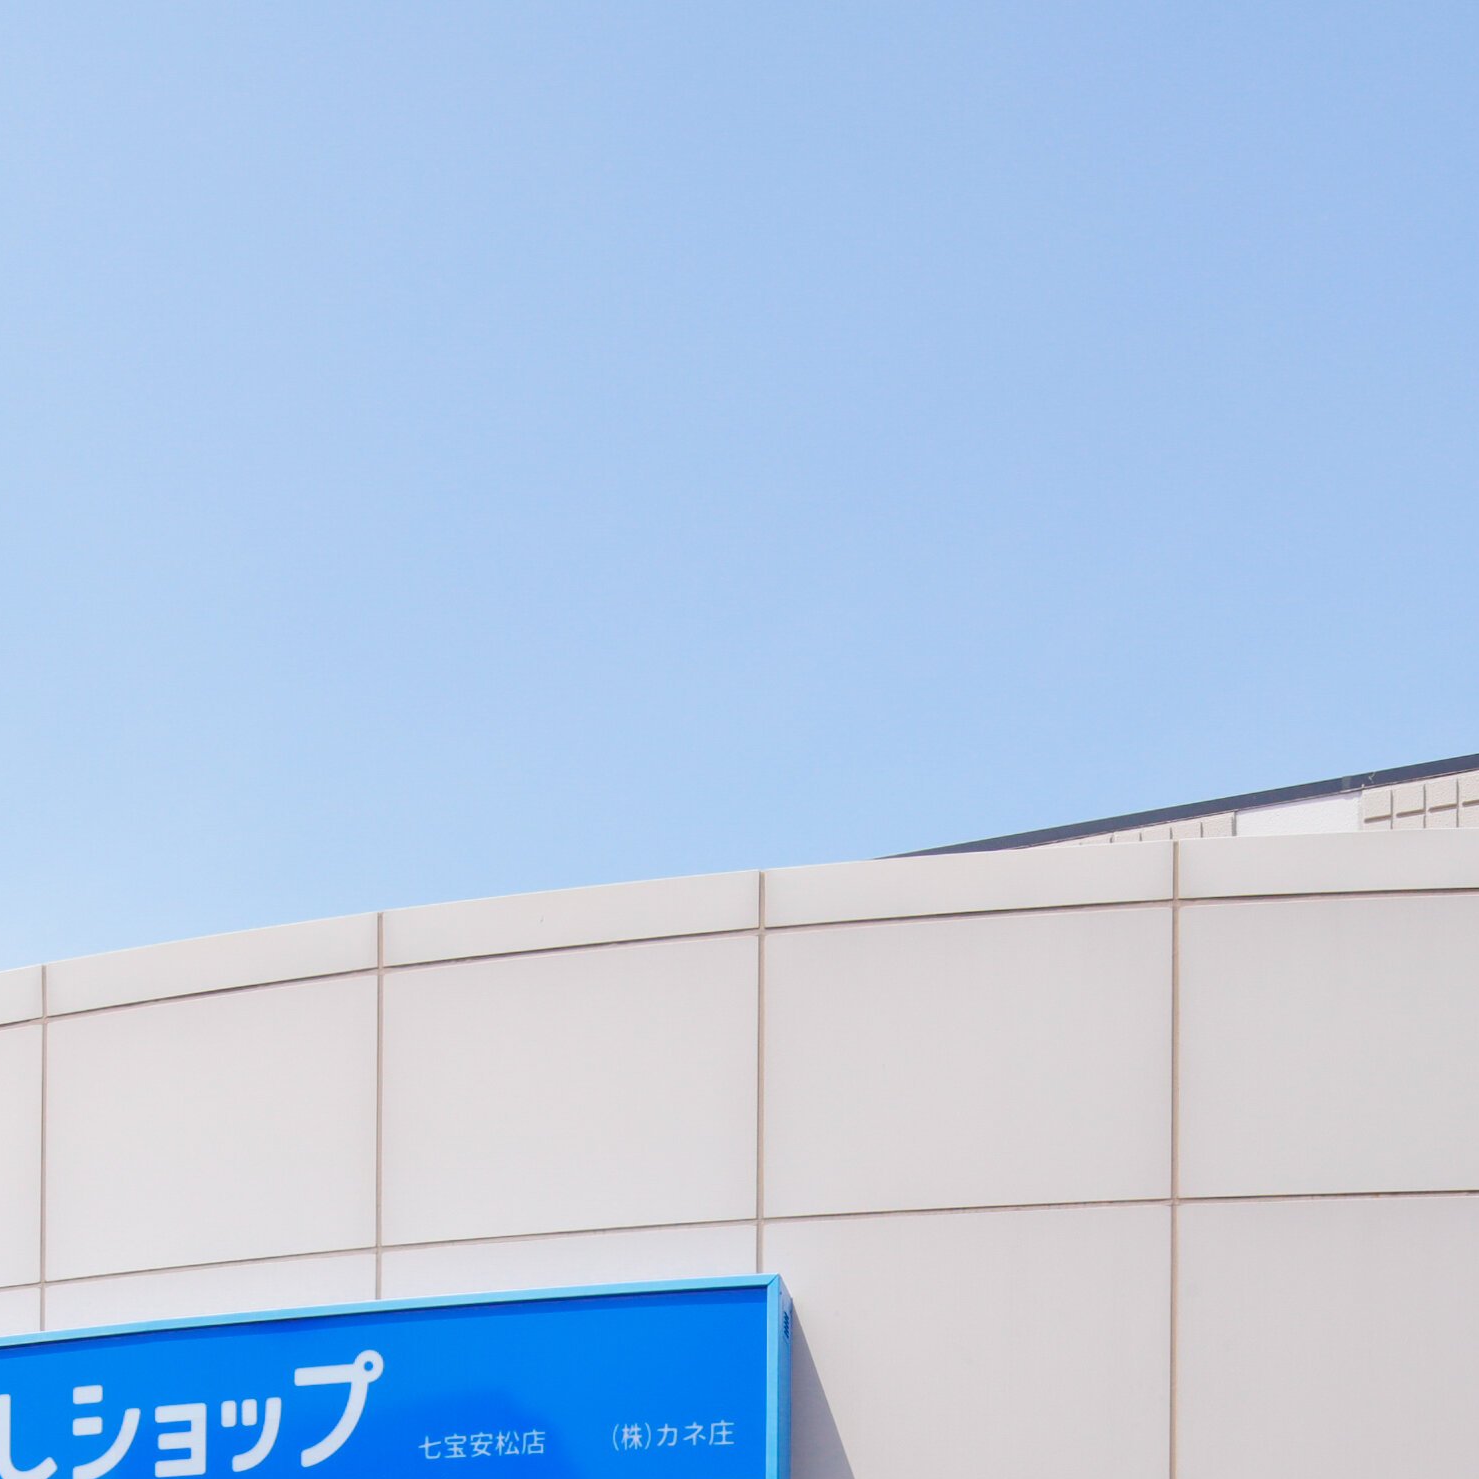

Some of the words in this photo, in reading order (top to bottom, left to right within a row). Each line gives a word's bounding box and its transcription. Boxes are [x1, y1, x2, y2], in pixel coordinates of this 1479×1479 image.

[418, 1428, 546, 1461] 七宝安松店
[611, 1420, 735, 1451] (株)カネ庄
